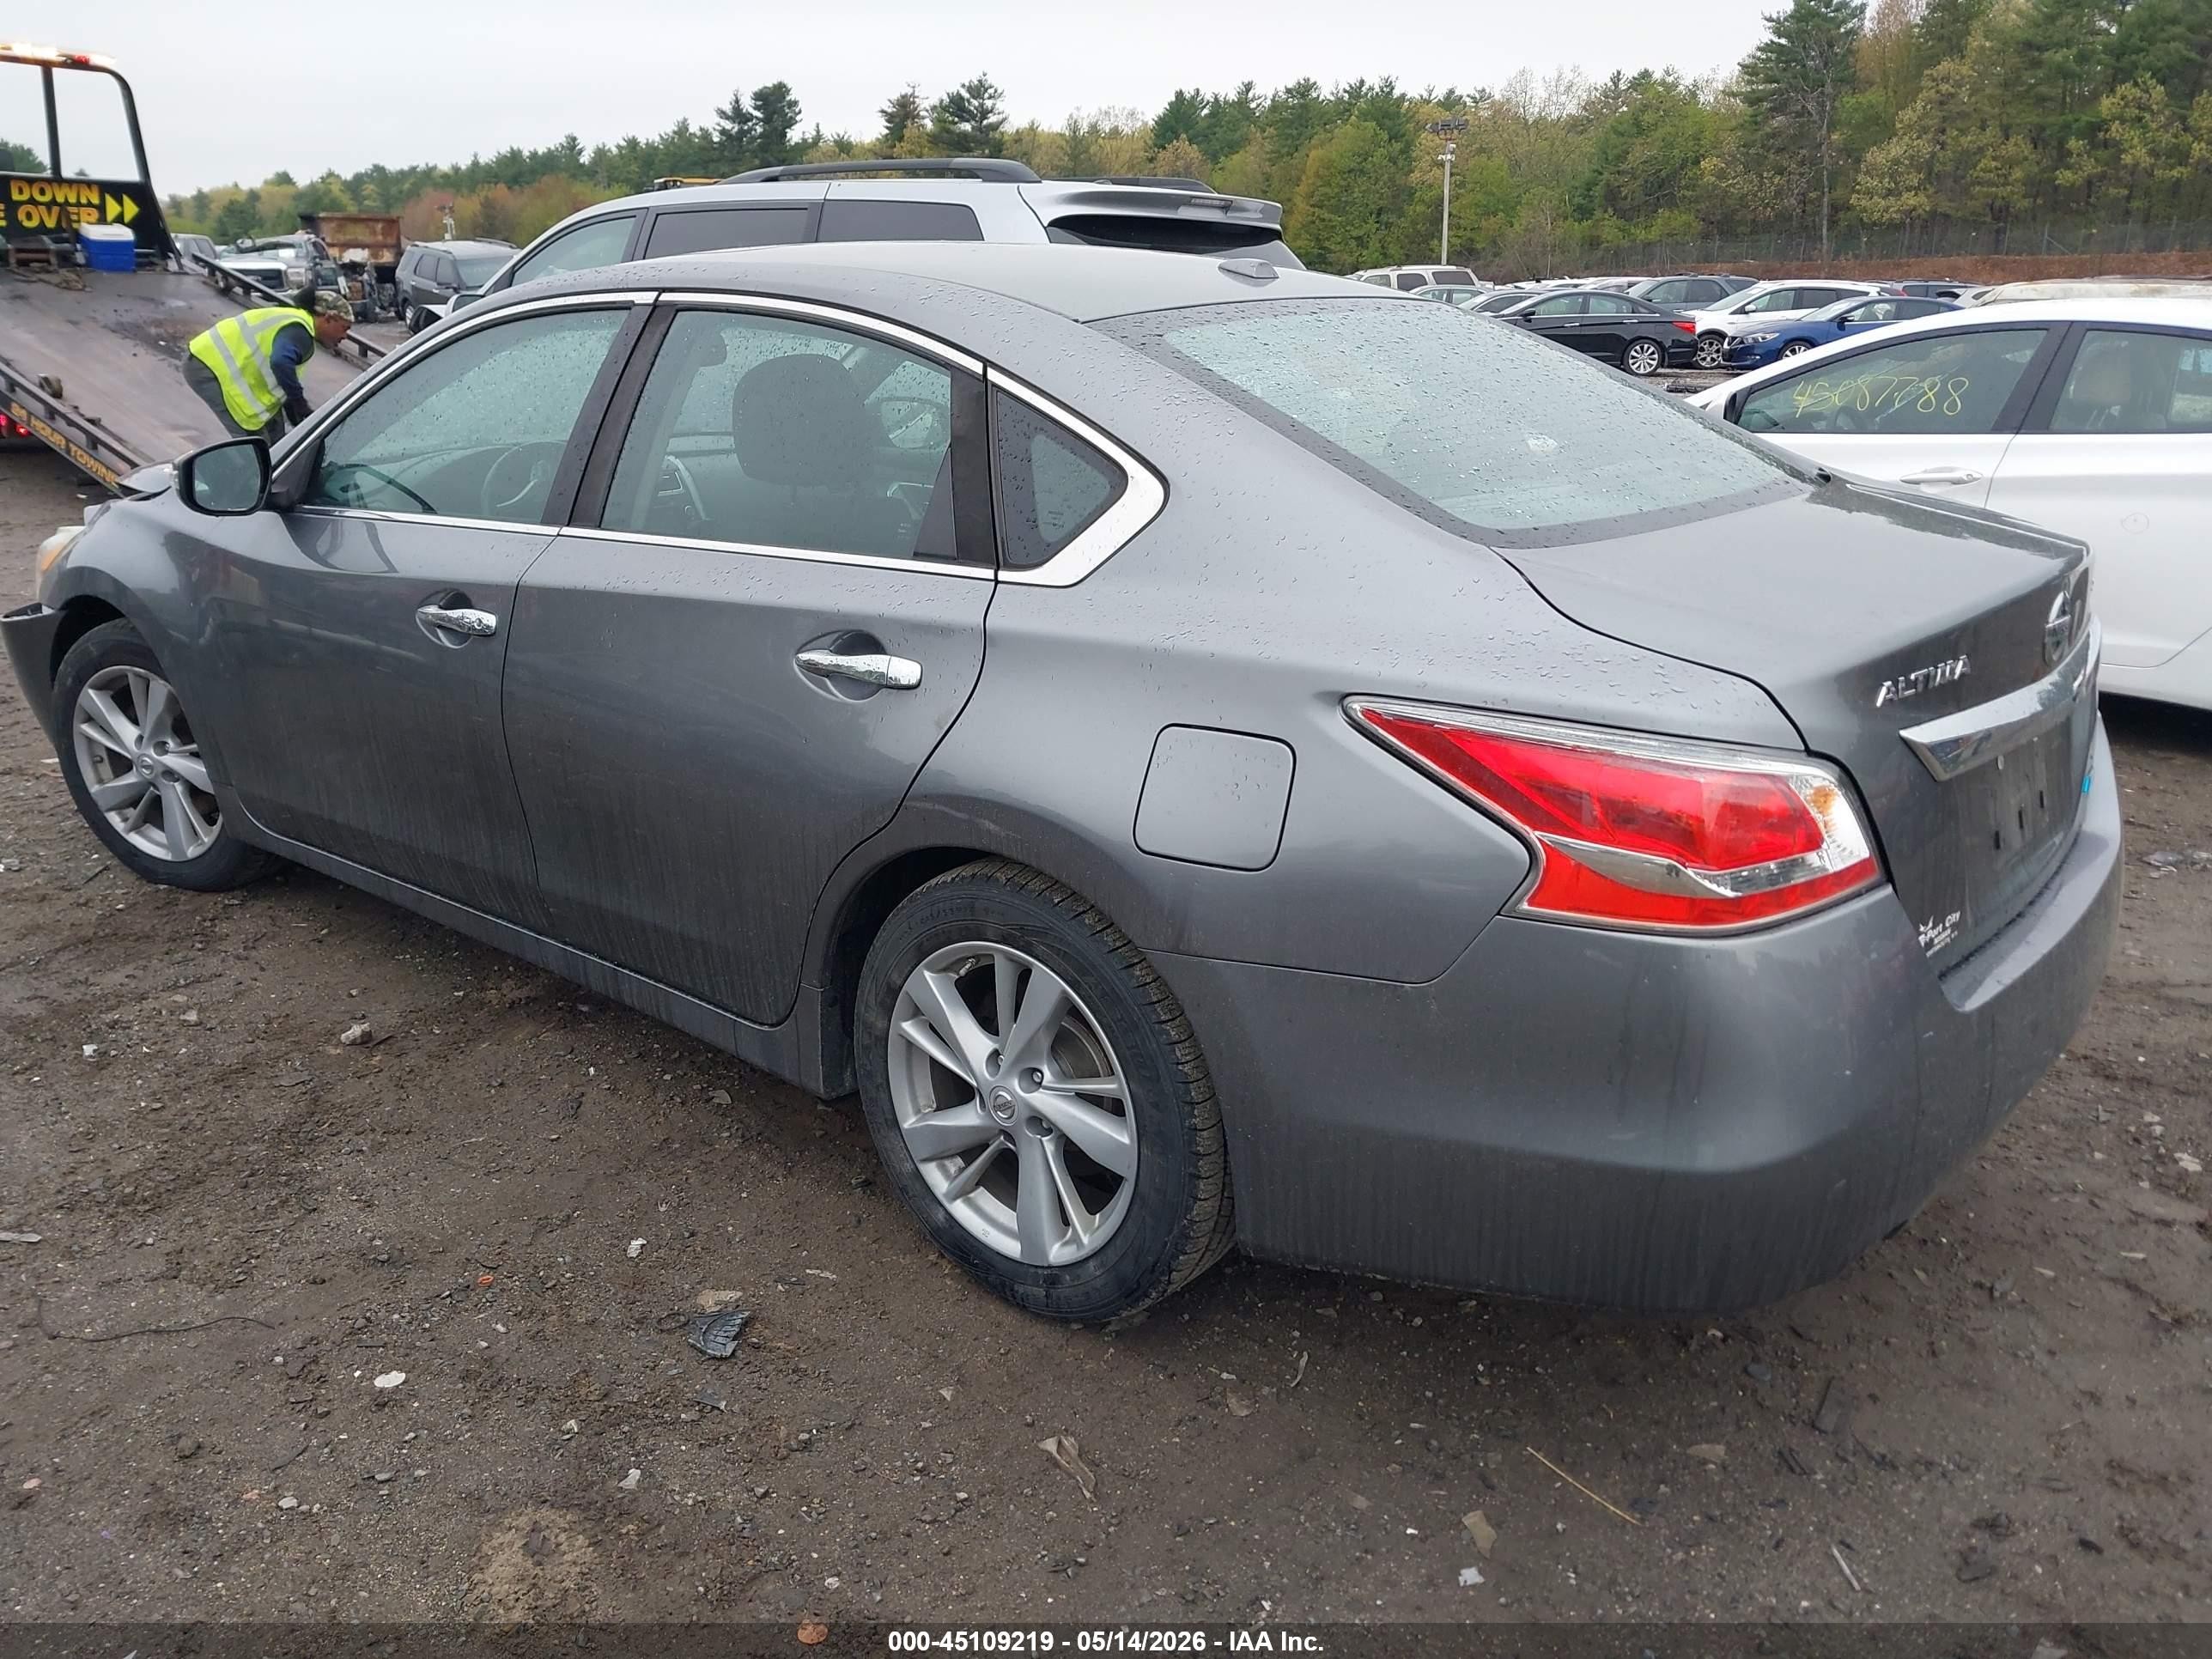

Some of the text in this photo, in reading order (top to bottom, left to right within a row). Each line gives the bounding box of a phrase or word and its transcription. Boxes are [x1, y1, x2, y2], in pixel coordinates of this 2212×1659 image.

[10, 179, 100, 204] DOWN
[30, 415, 66, 449] HOUR
[1875, 654, 1971, 708] ALTIMA
